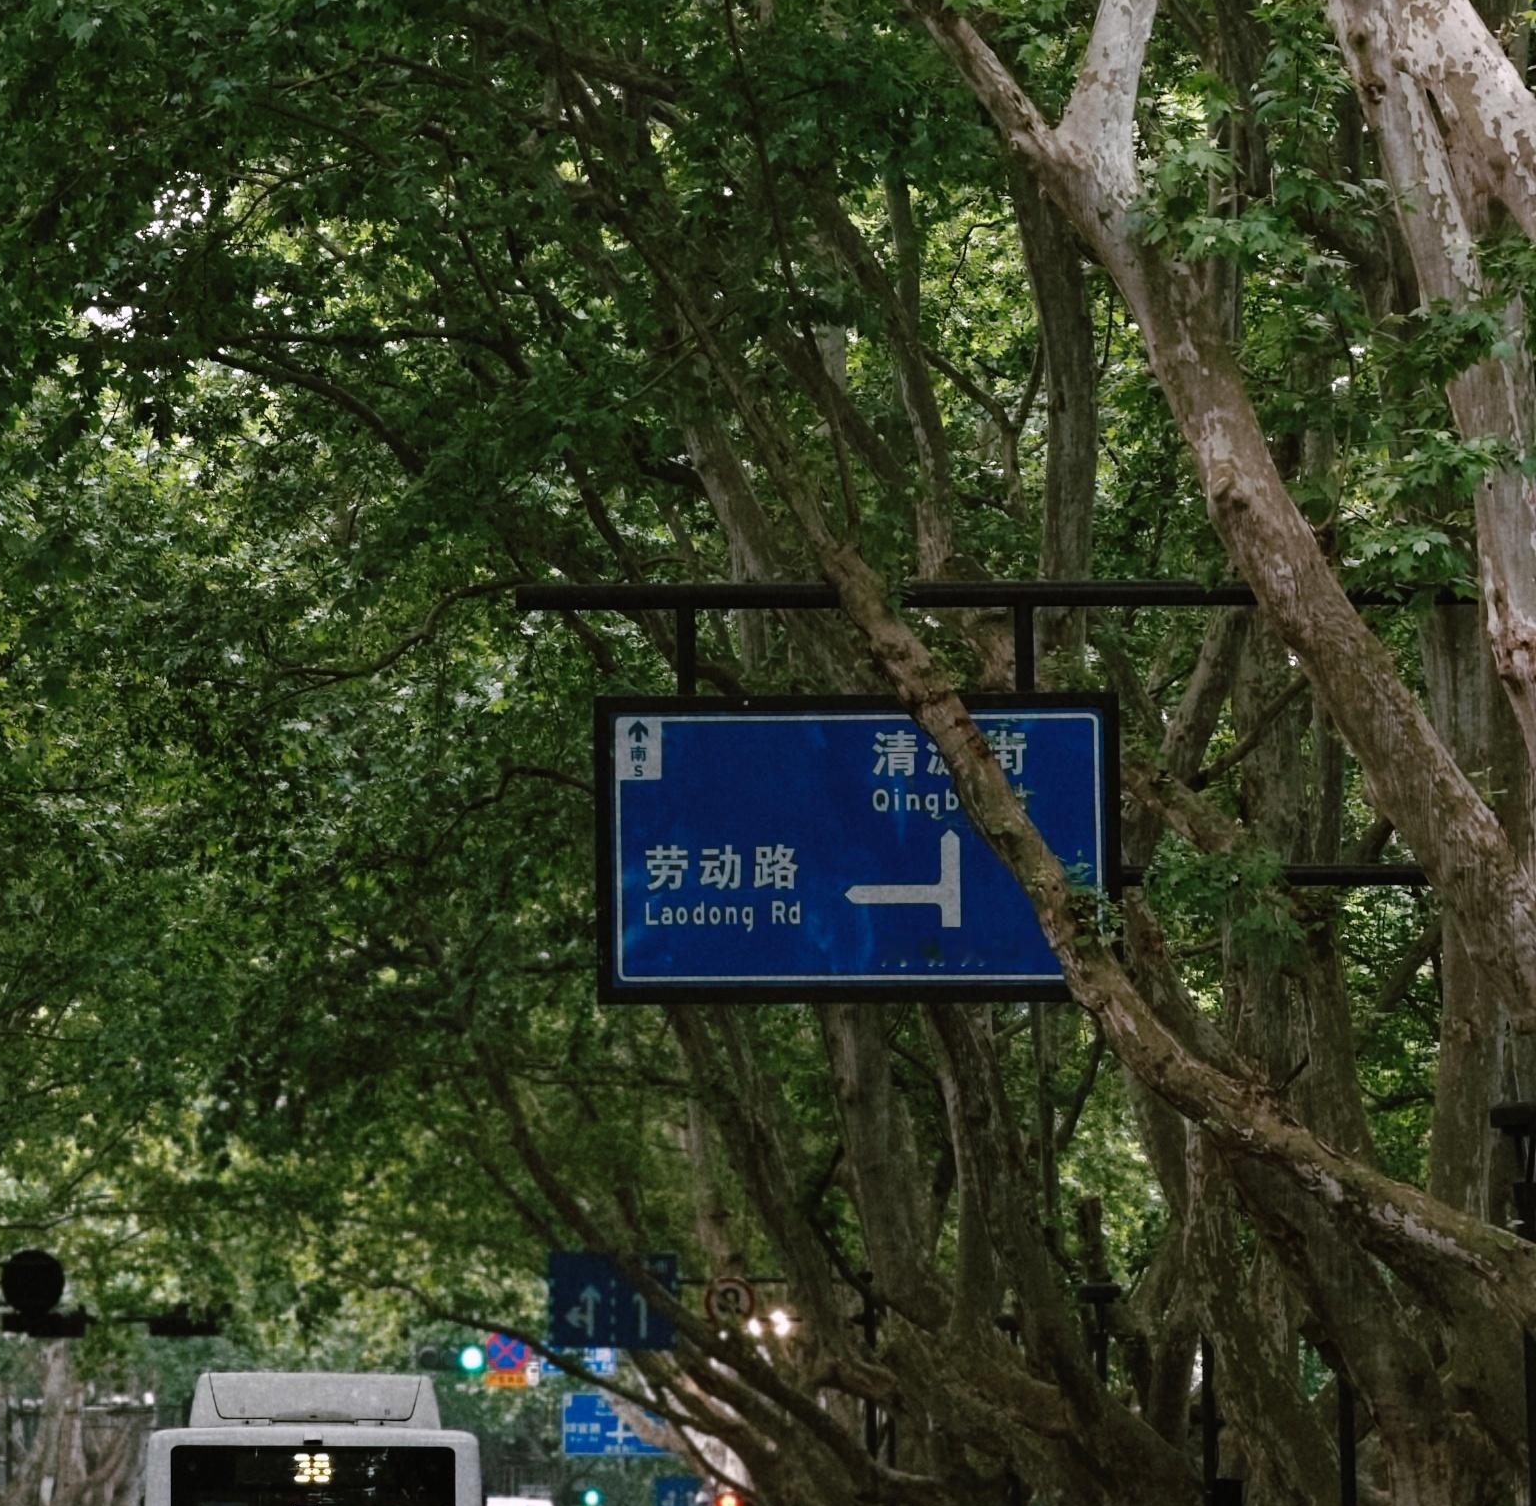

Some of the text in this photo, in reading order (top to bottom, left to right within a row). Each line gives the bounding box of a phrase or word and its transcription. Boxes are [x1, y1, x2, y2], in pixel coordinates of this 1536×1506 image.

[630, 745, 647, 762] 南
[634, 765, 644, 777] S
[872, 788, 960, 818] Qingb
[645, 844, 799, 890] 劳动路
[645, 900, 801, 933] Laodong Rd
